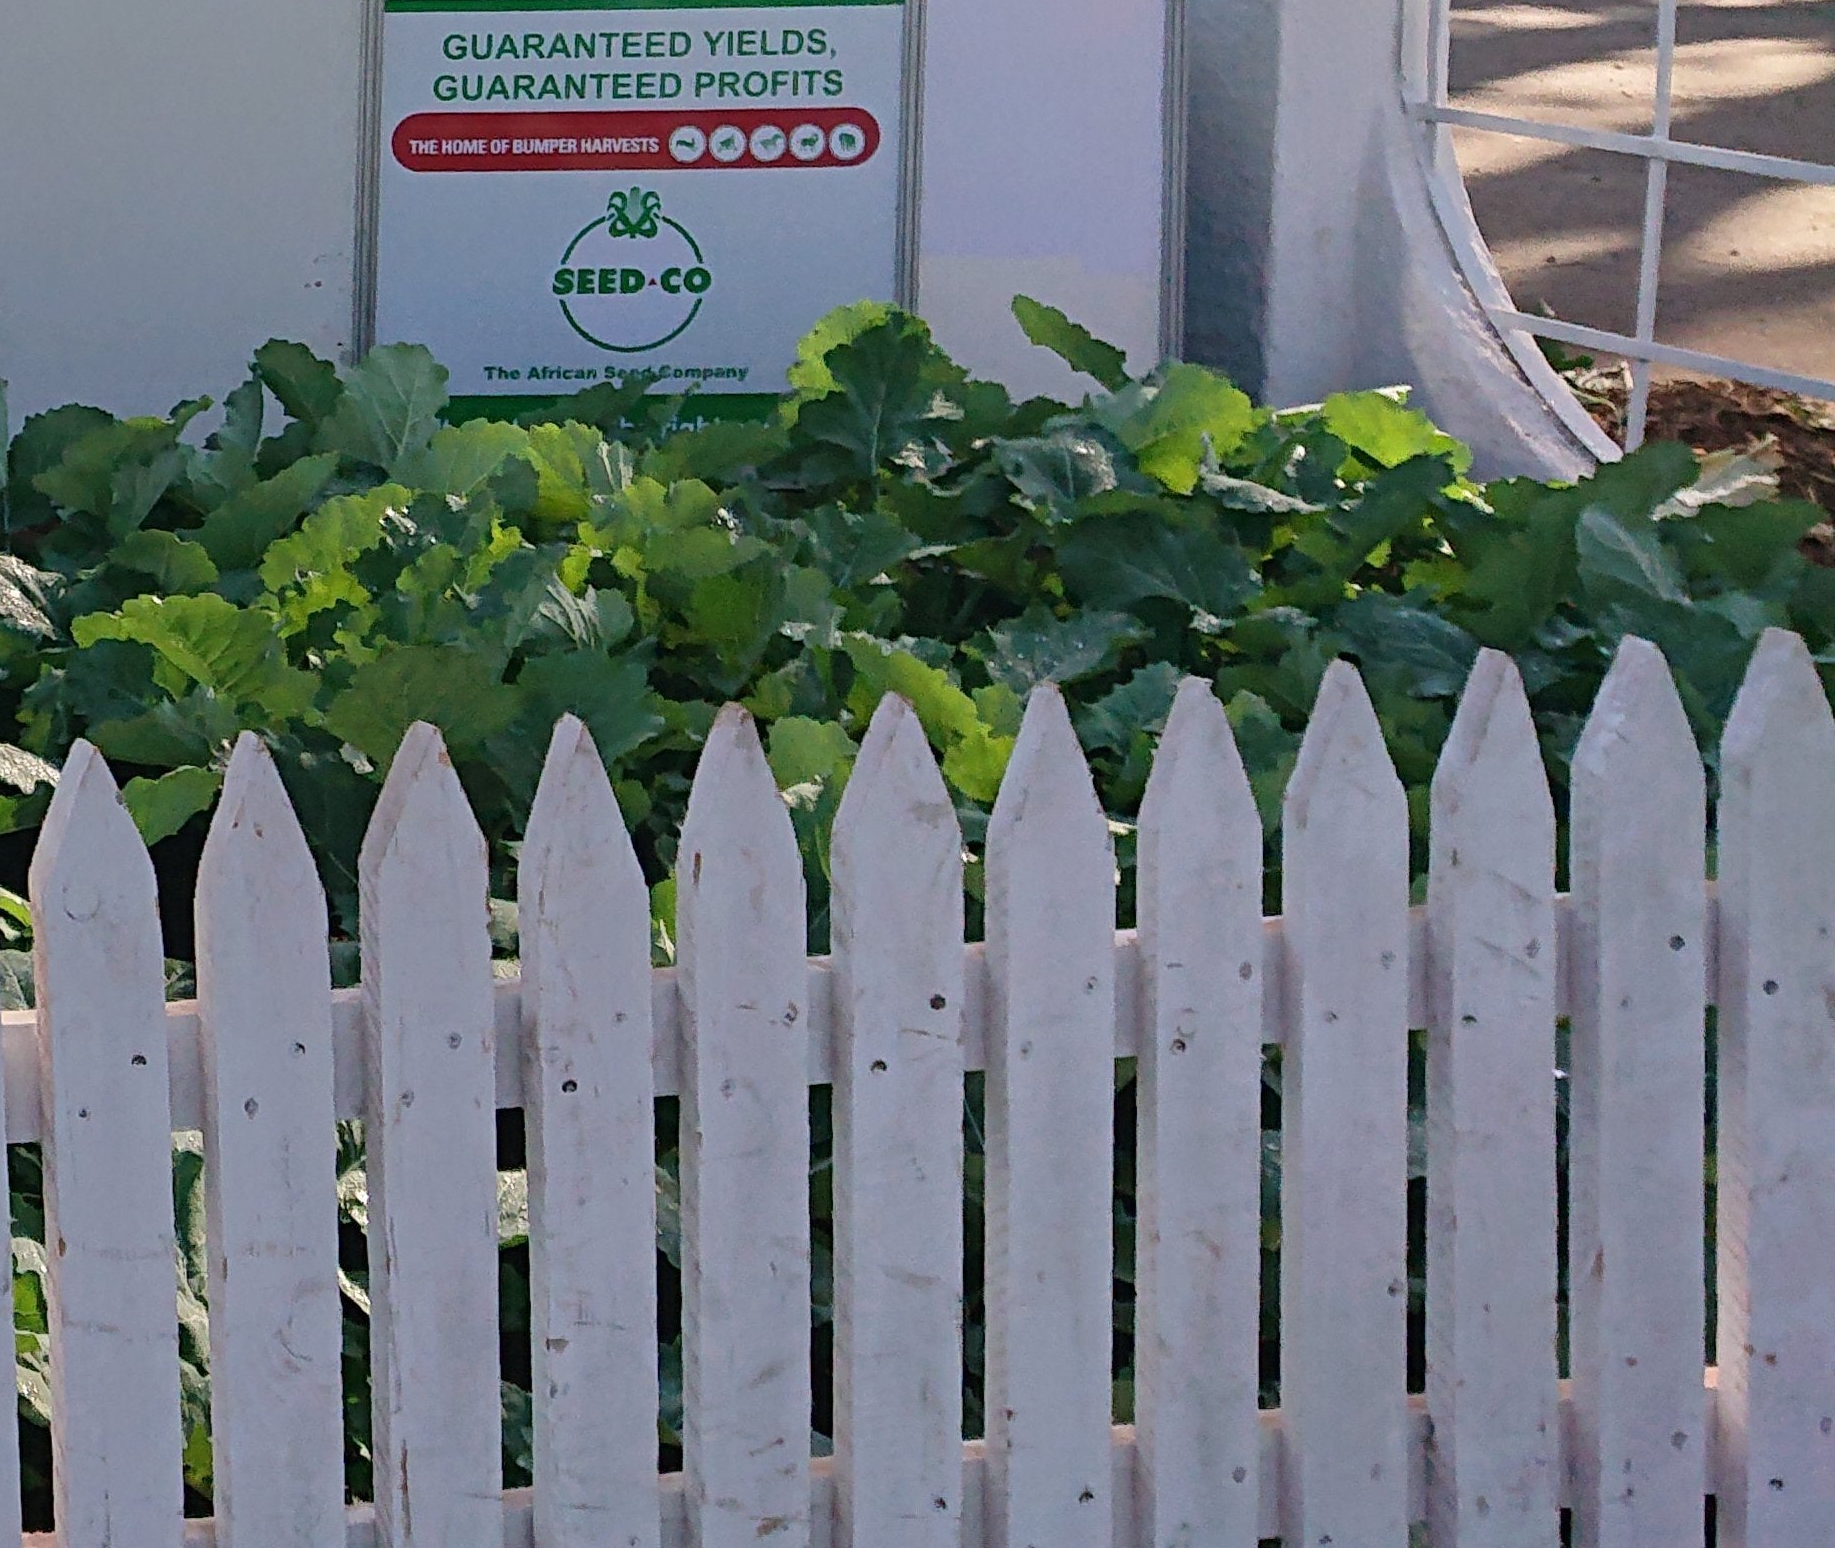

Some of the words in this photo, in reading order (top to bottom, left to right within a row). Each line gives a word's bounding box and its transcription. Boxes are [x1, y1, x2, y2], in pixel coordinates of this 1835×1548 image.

[442, 31, 692, 61] GUARANTEED
[702, 28, 837, 59] YIELDS,
[432, 72, 682, 102] GUARANTEED
[694, 70, 843, 99] PROFITS
[409, 139, 439, 154] THE
[441, 138, 487, 155] HOME
[490, 138, 510, 154] OF
[512, 137, 577, 154] BUMPER
[580, 136, 659, 154] HARVESTS
[552, 268, 646, 295] SEED
[660, 266, 712, 293] CO
[484, 366, 520, 381] The
[527, 365, 598, 381] African
[659, 365, 749, 383] Company
